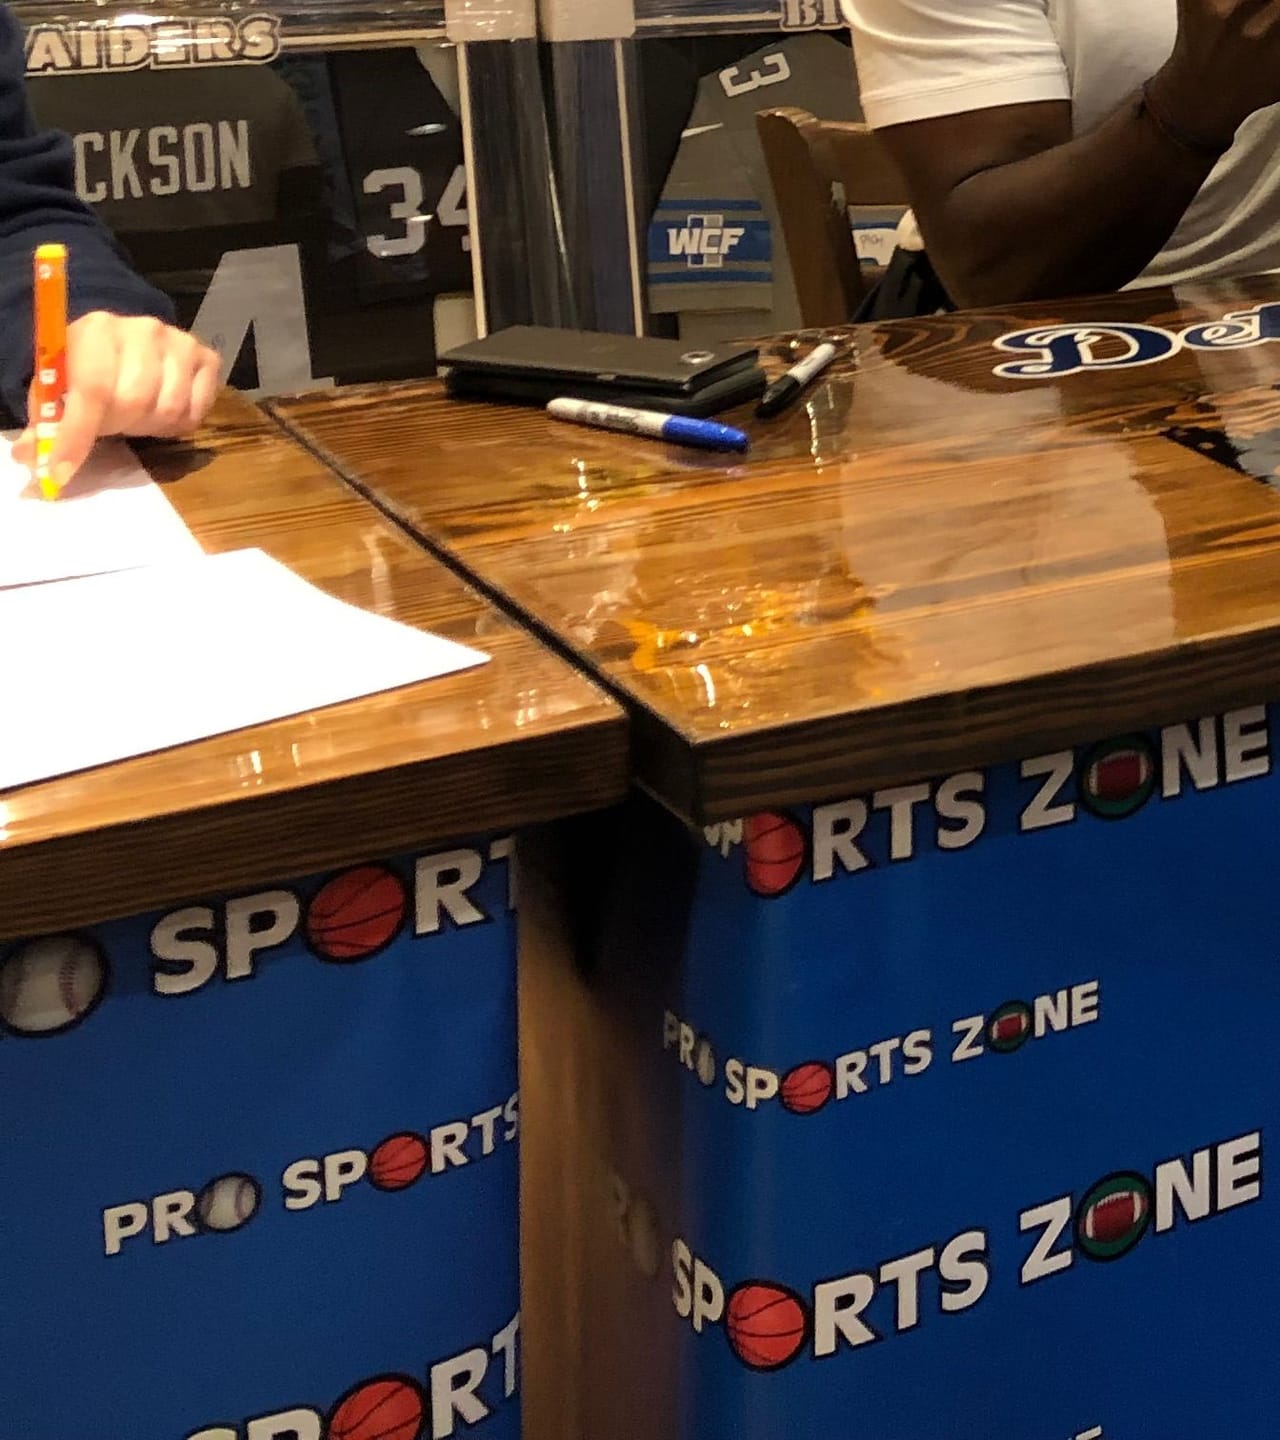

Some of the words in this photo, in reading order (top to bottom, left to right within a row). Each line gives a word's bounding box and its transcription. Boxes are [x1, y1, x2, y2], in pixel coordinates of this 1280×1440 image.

[25, 15, 282, 74] AIDERS
[73, 119, 252, 204] CKSON
[667, 227, 745, 256] WCF
[1019, 703, 1272, 833] ZONE
[724, 1029, 933, 1115] SPORTS
[951, 980, 1100, 1061] ZONE
[102, 1169, 262, 1257] PRO
[671, 1229, 989, 1373] SPORTS
[1019, 1128, 1264, 1283] ZONE
